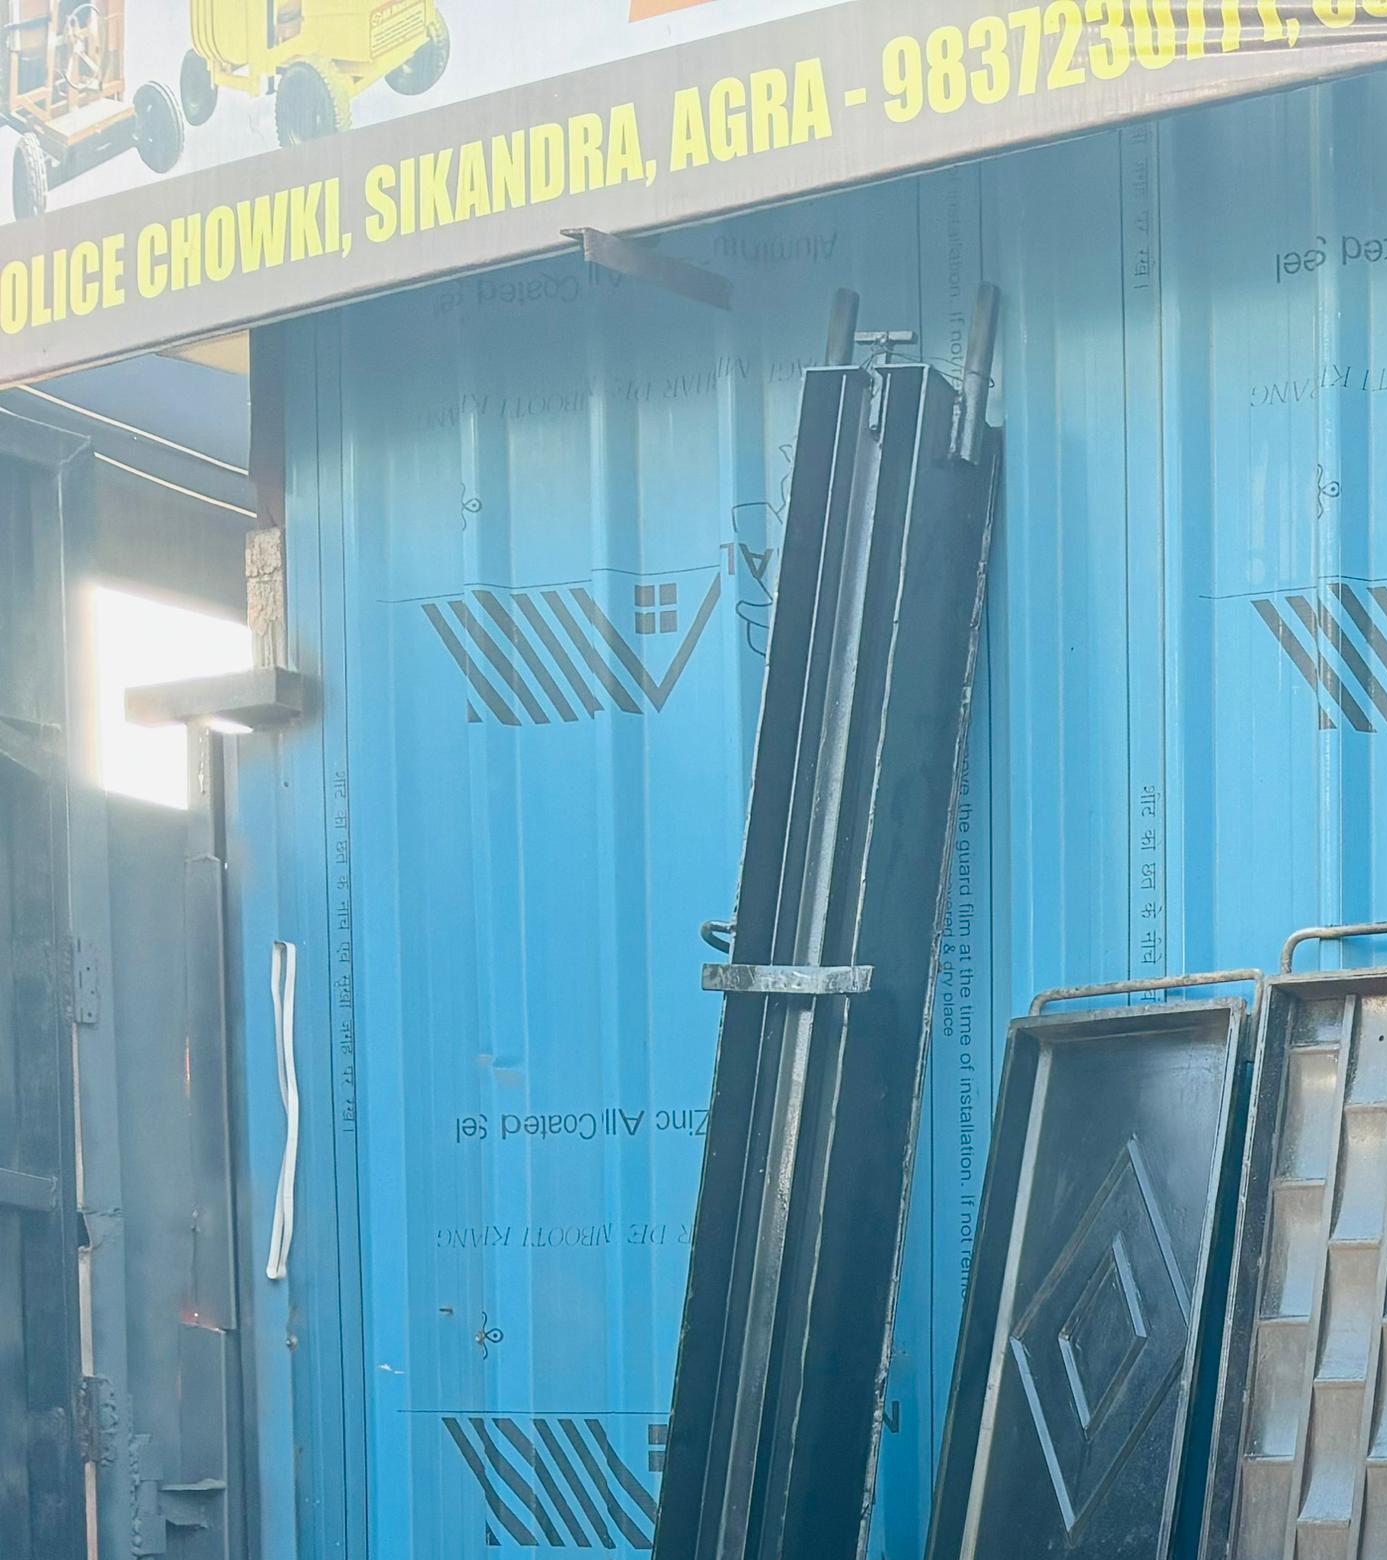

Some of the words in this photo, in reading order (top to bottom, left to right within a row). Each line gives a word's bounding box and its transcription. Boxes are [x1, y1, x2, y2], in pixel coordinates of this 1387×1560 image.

[137, 177, 352, 298] CHOWKI,
[364, 101, 656, 243] SIKANDRA,
[669, 56, 832, 172] AGRA
[957, 803, 975, 833] the
[954, 840, 975, 895] guard
[958, 904, 977, 936] film
[958, 944, 975, 961] at
[940, 961, 957, 987] dry
[958, 968, 976, 998] the
[941, 992, 957, 1037] place
[959, 1005, 976, 1046] time
[959, 1052, 976, 1072] of
[501, 1113, 597, 1142] Coated
[959, 1078, 976, 1187] installation.
[959, 1194, 977, 1210] If
[959, 1213, 976, 1242] not
